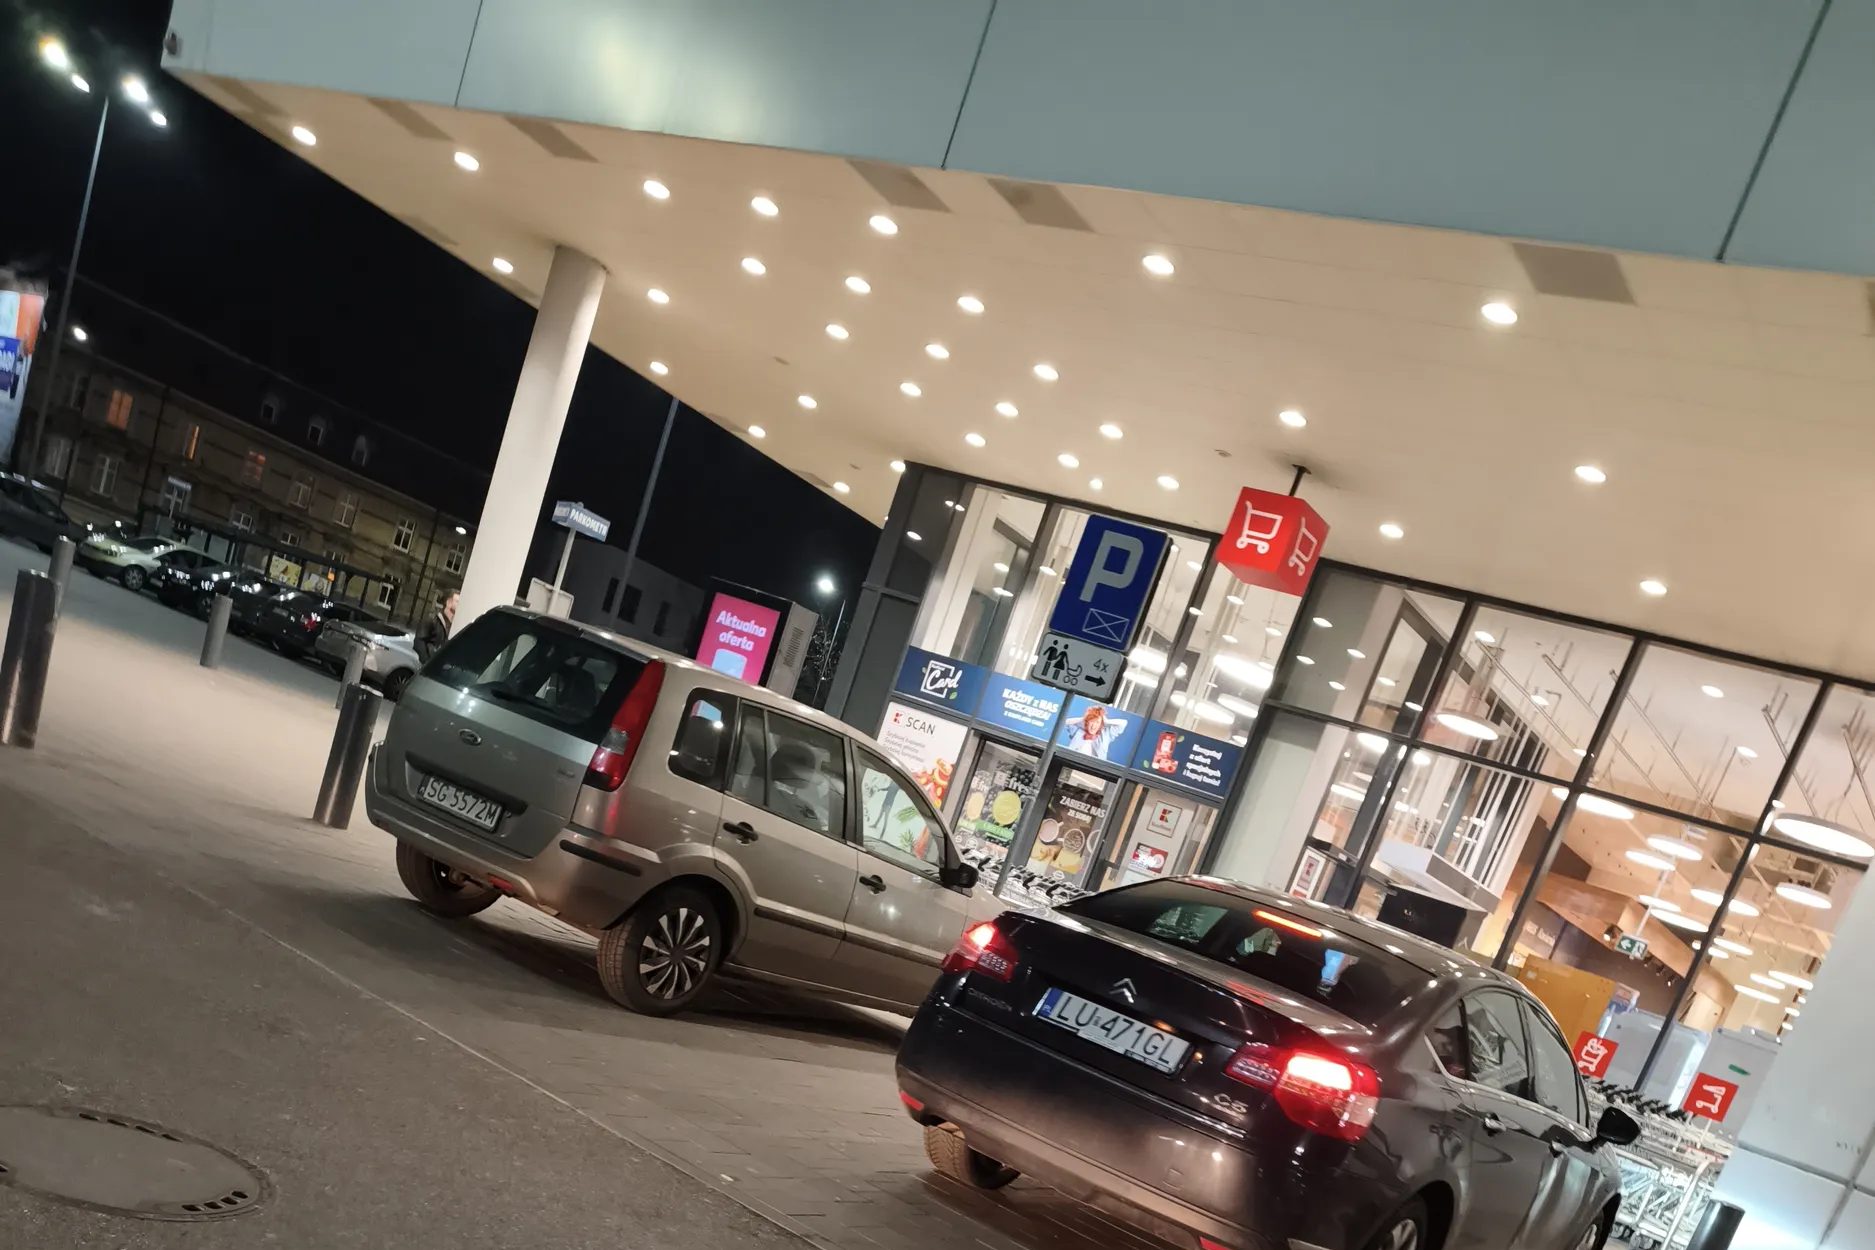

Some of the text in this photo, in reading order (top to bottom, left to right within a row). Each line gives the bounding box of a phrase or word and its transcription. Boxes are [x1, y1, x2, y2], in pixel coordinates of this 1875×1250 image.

[1079, 530, 1144, 602] P
[716, 610, 767, 637] Aktualna
[719, 630, 754, 651] oferta
[1093, 658, 1110, 673] 4x
[926, 669, 963, 690] Card
[906, 716, 936, 735] SCAN
[427, 777, 447, 802] SG
[1060, 796, 1106, 818] ZABIERZ NAS
[1057, 996, 1099, 1027] LU
[1100, 1015, 1173, 1065] 471GL
